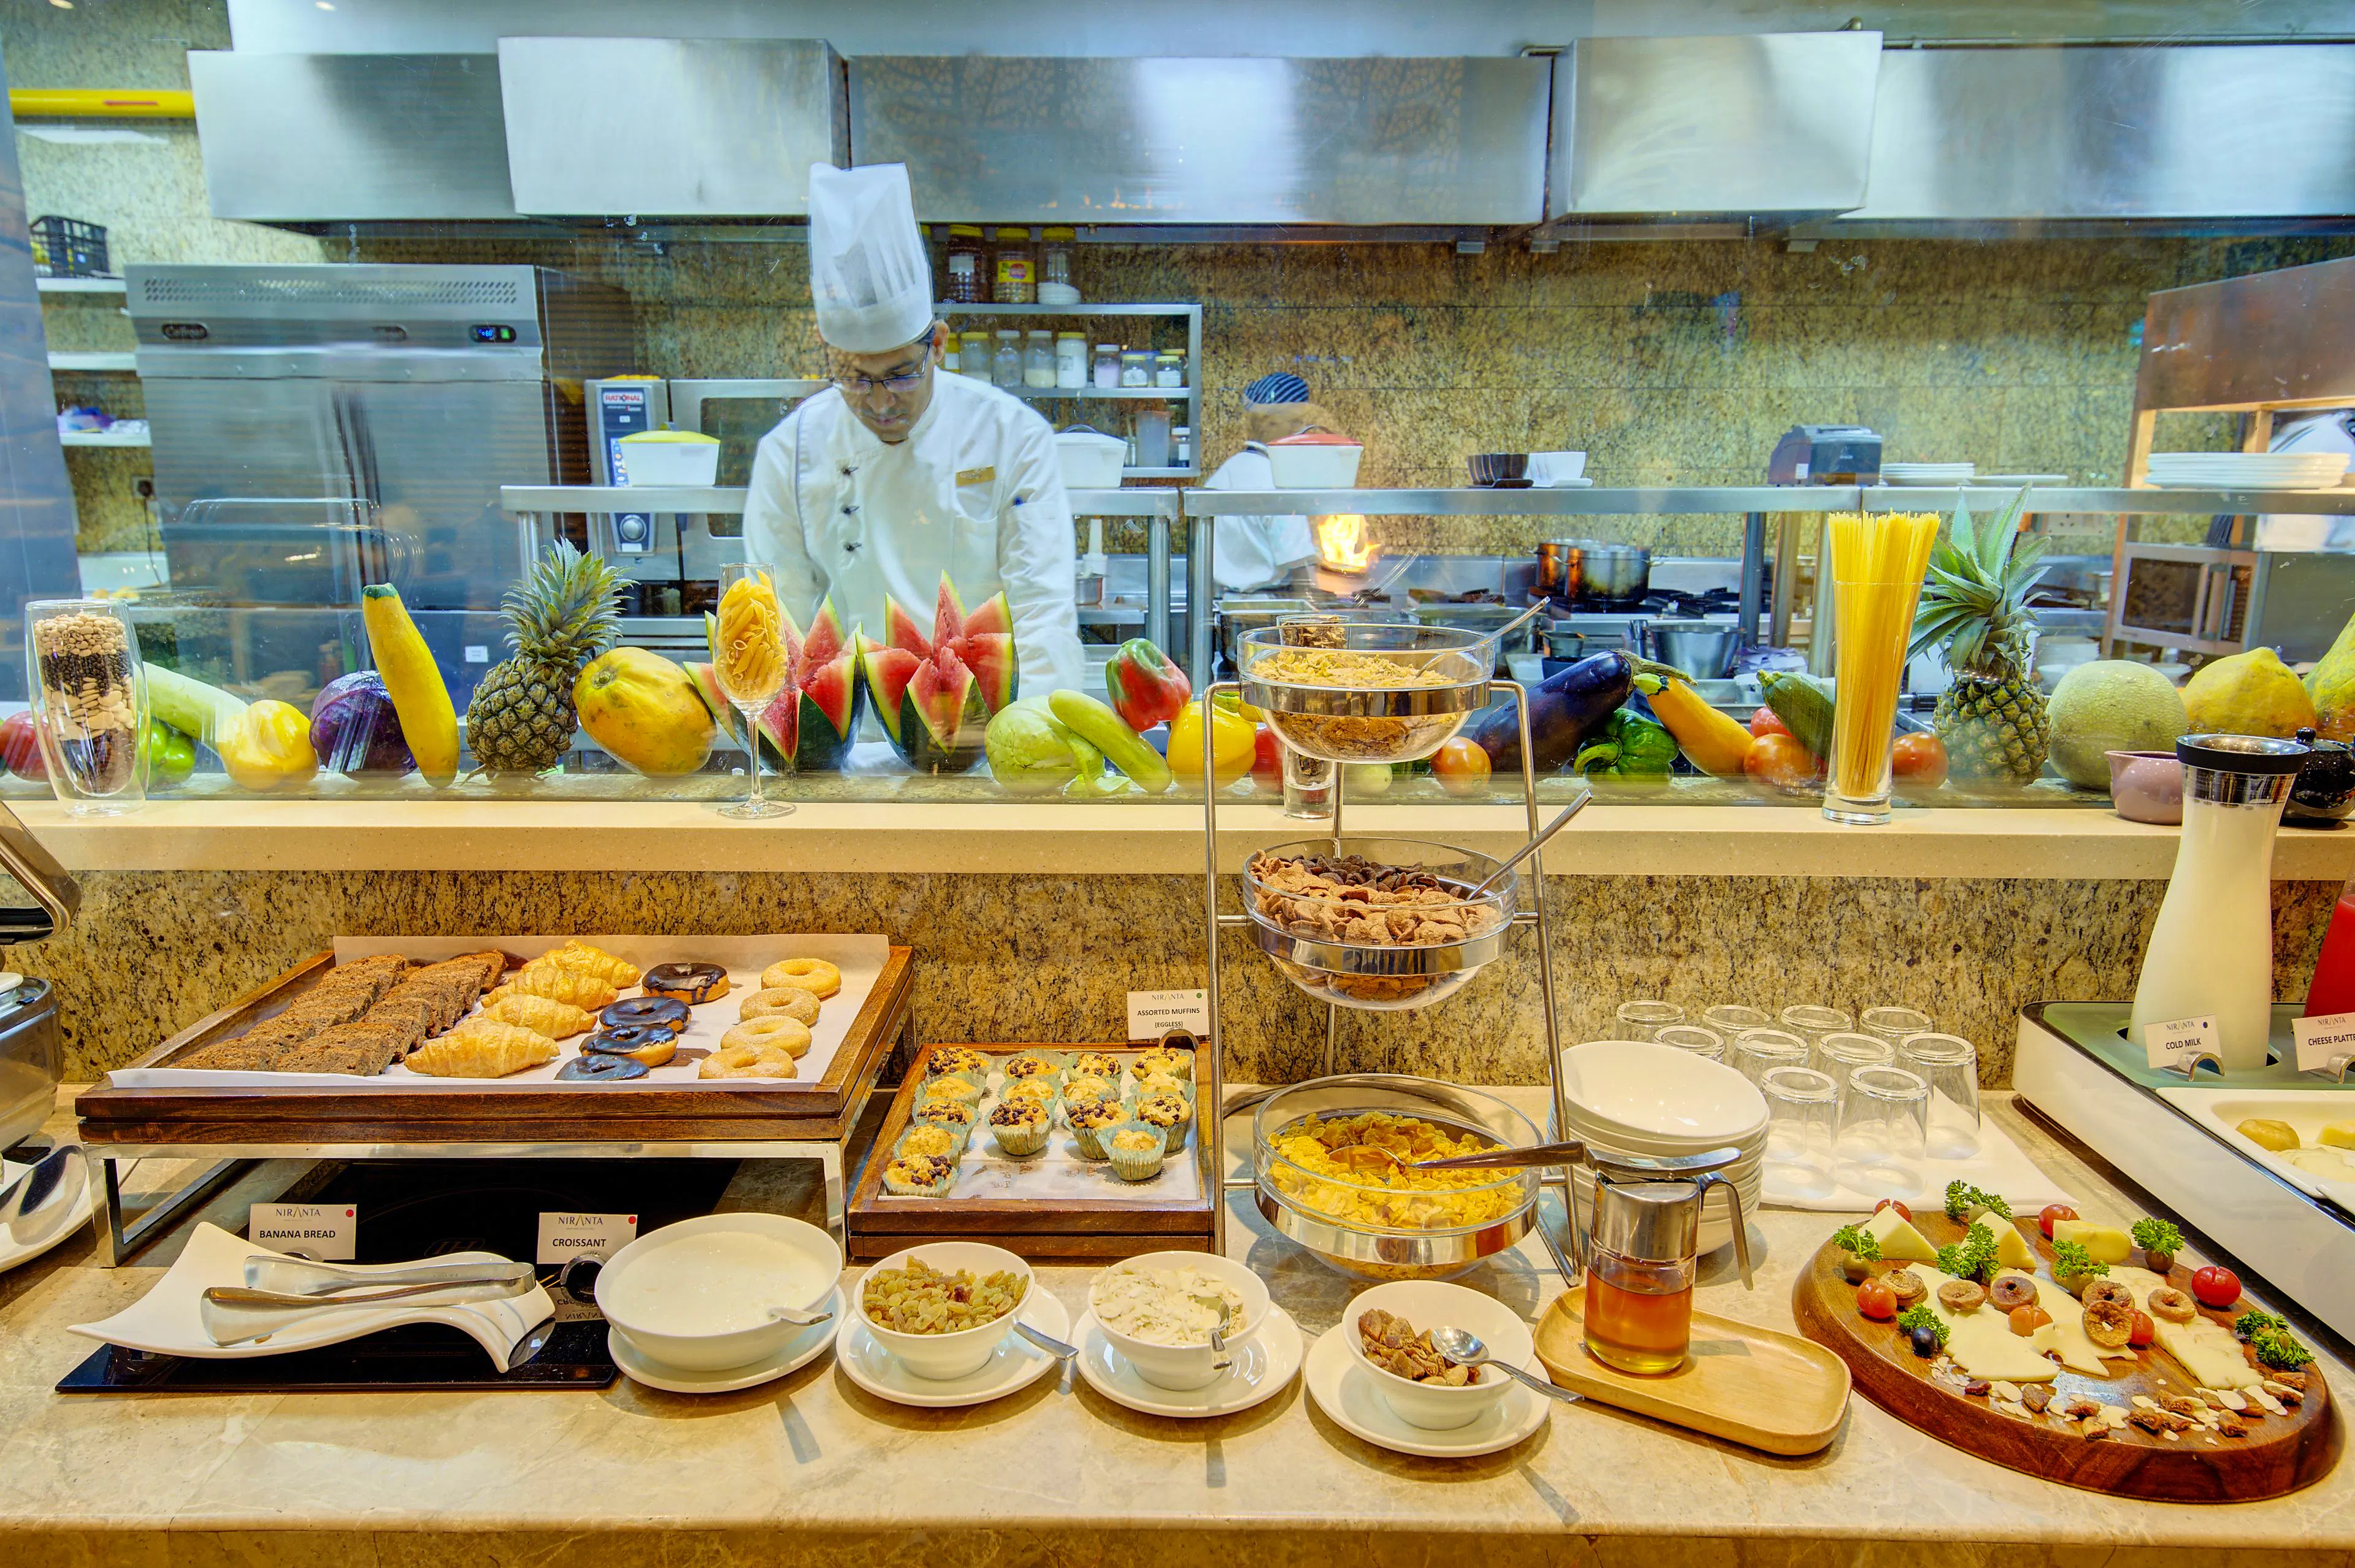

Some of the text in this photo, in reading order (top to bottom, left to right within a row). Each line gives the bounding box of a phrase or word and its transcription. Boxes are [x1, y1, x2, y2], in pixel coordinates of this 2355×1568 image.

[2166, 1020, 2195, 1031] NIRANTA
[2318, 1017, 2346, 1026] NIRANTA
[2165, 1038, 2201, 1050] COLD MILK
[2308, 1036, 2333, 1046] CHEESE
[276, 1206, 321, 1218] NIRANTA
[558, 1215, 603, 1226] NIRANTA
[553, 1238, 607, 1247] CROISSANT
